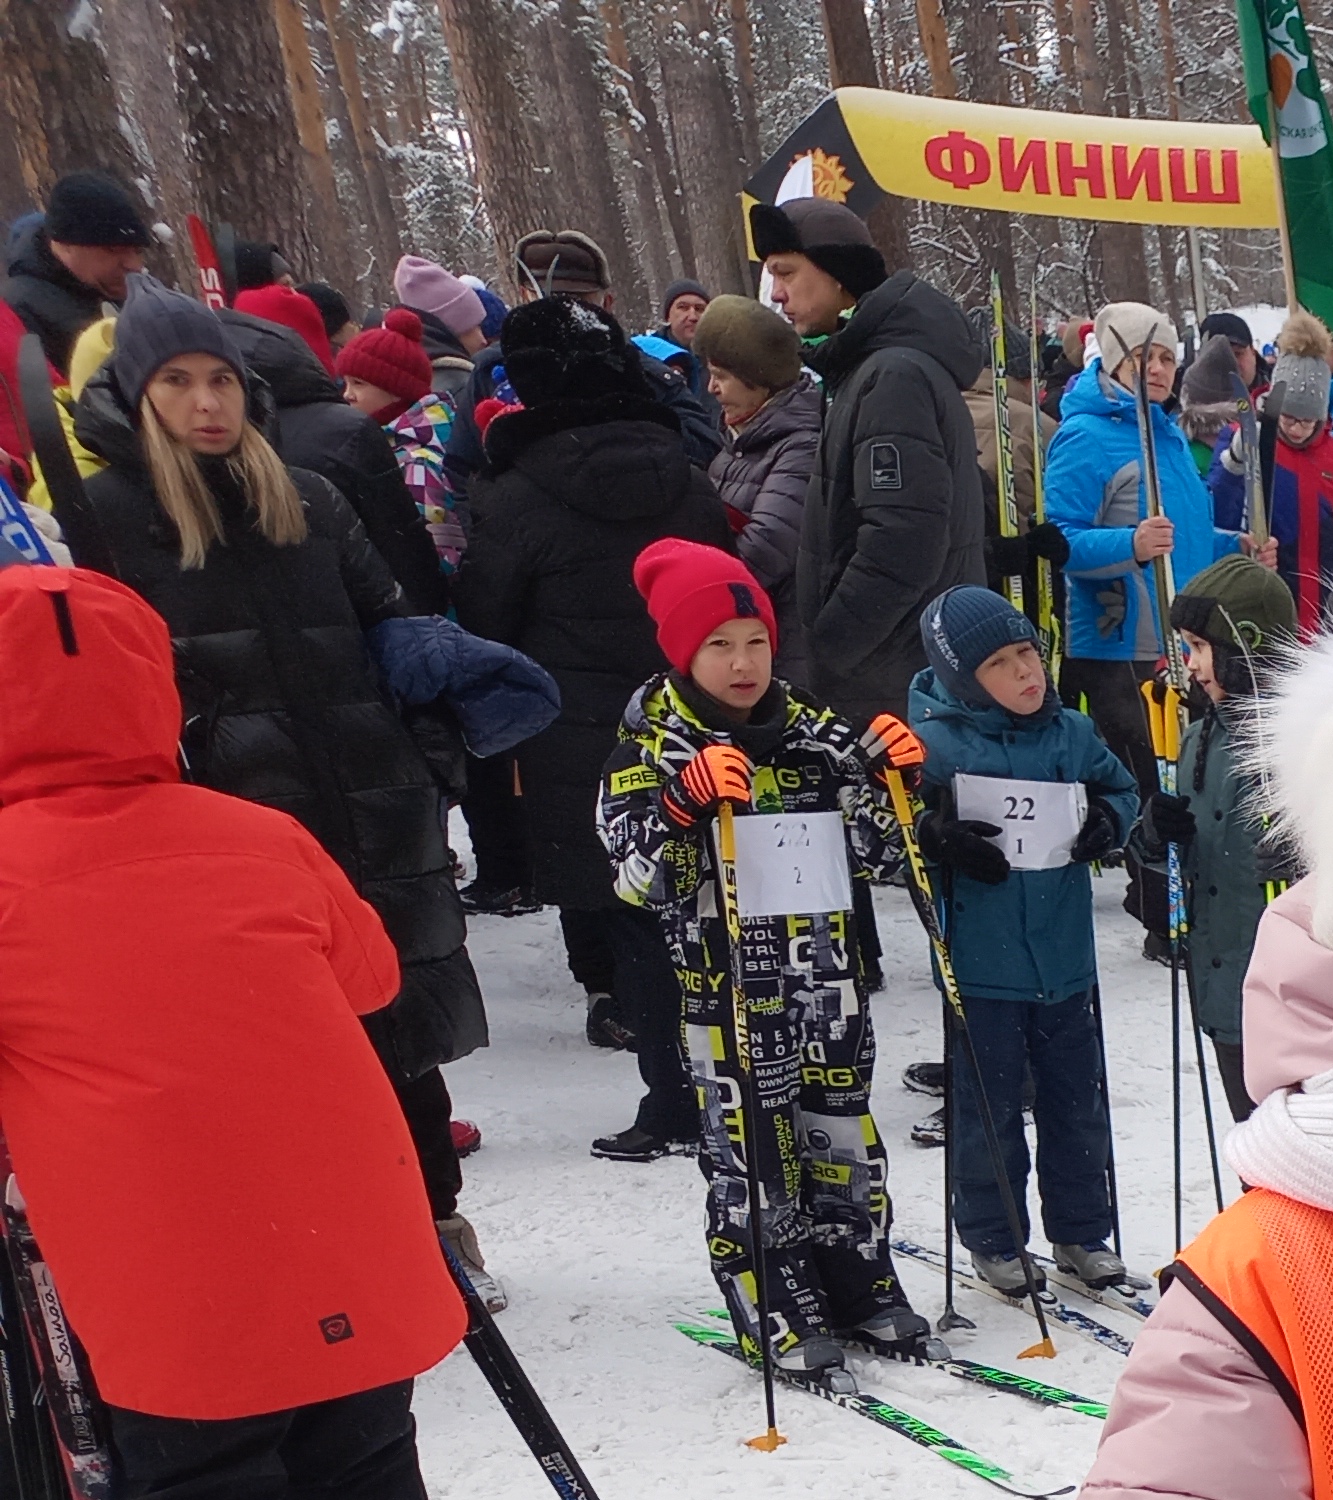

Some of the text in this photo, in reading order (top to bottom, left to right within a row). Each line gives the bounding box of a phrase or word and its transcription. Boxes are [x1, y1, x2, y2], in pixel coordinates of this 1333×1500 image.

[923, 130, 1241, 204] ФИНИШ
[1003, 795, 1036, 821] 22
[1015, 837, 1025, 855] 1
[973, 1366, 1071, 1402] ACTIVE
[868, 1402, 950, 1446] ACTIVE
